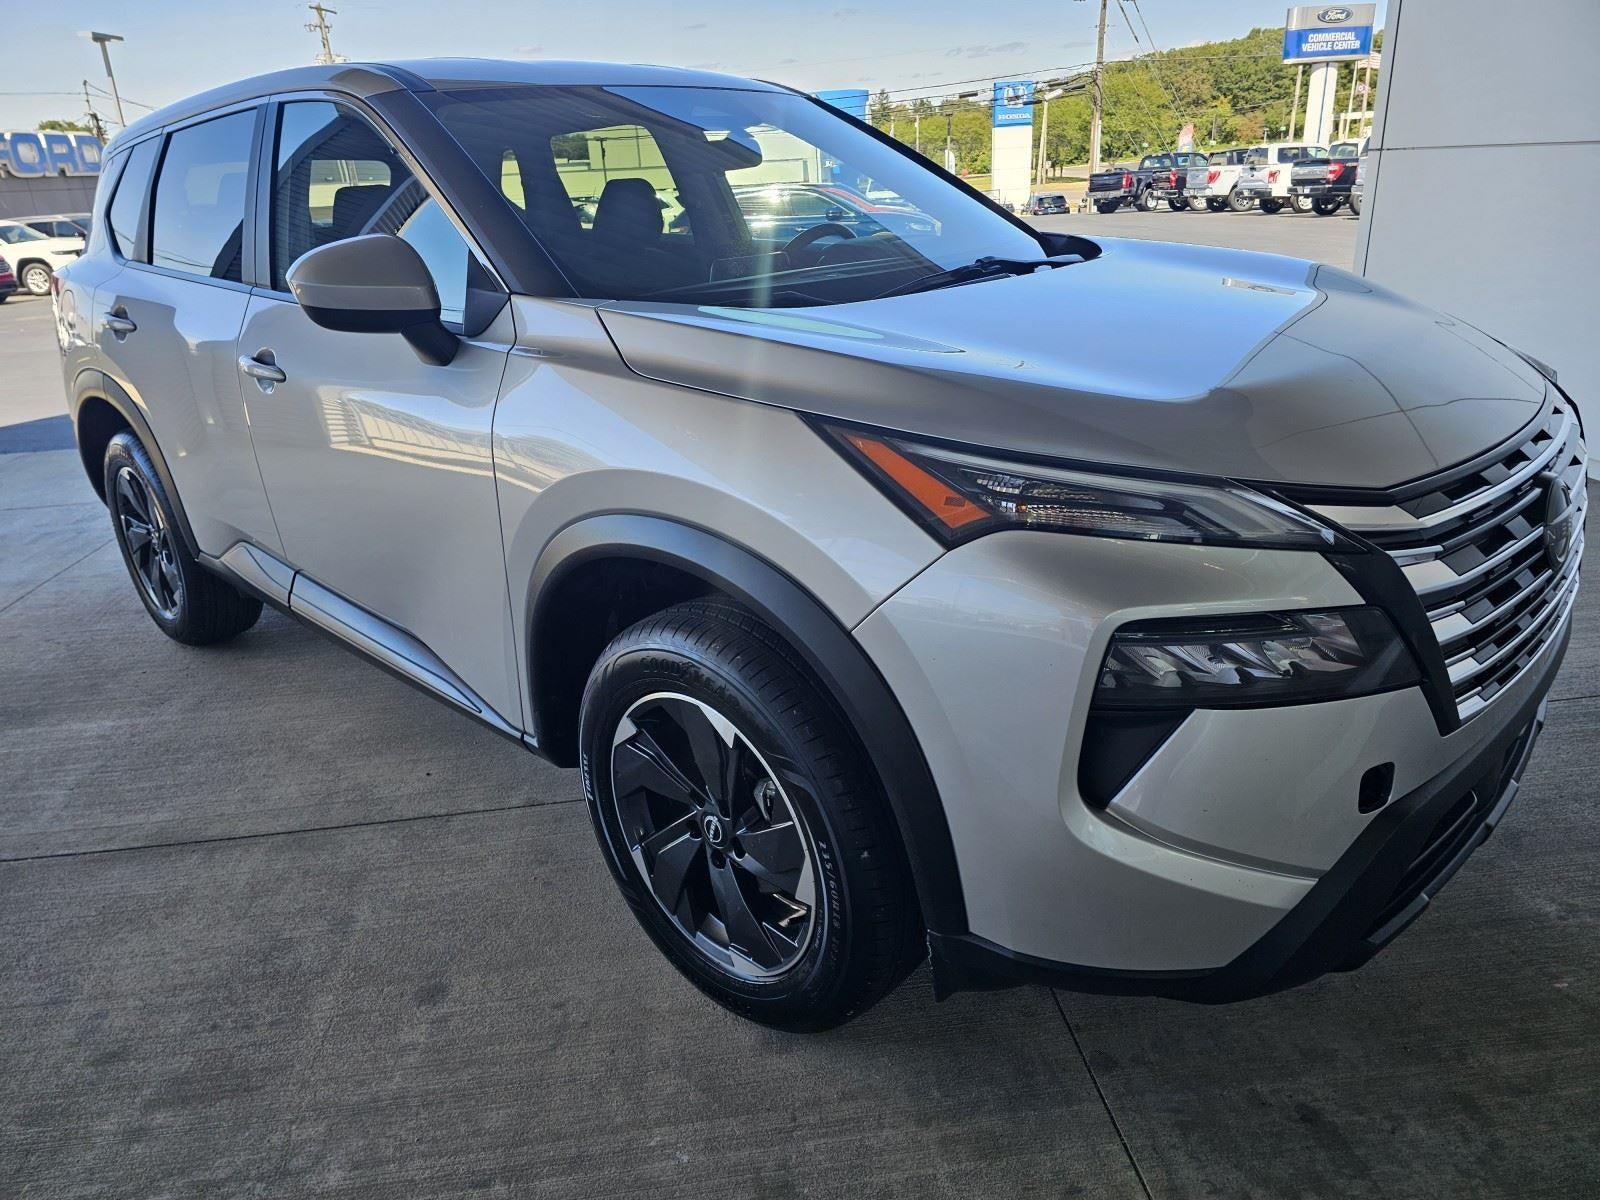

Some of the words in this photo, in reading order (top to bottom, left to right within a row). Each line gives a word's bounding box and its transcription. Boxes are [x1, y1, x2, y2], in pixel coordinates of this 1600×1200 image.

[1325, 8, 1347, 20] Ford
[1308, 32, 1356, 42] COMMERCIAL
[1302, 41, 1332, 52] VEHICLE
[1333, 40, 1360, 50] CENTER
[0, 131, 104, 178] ORD
